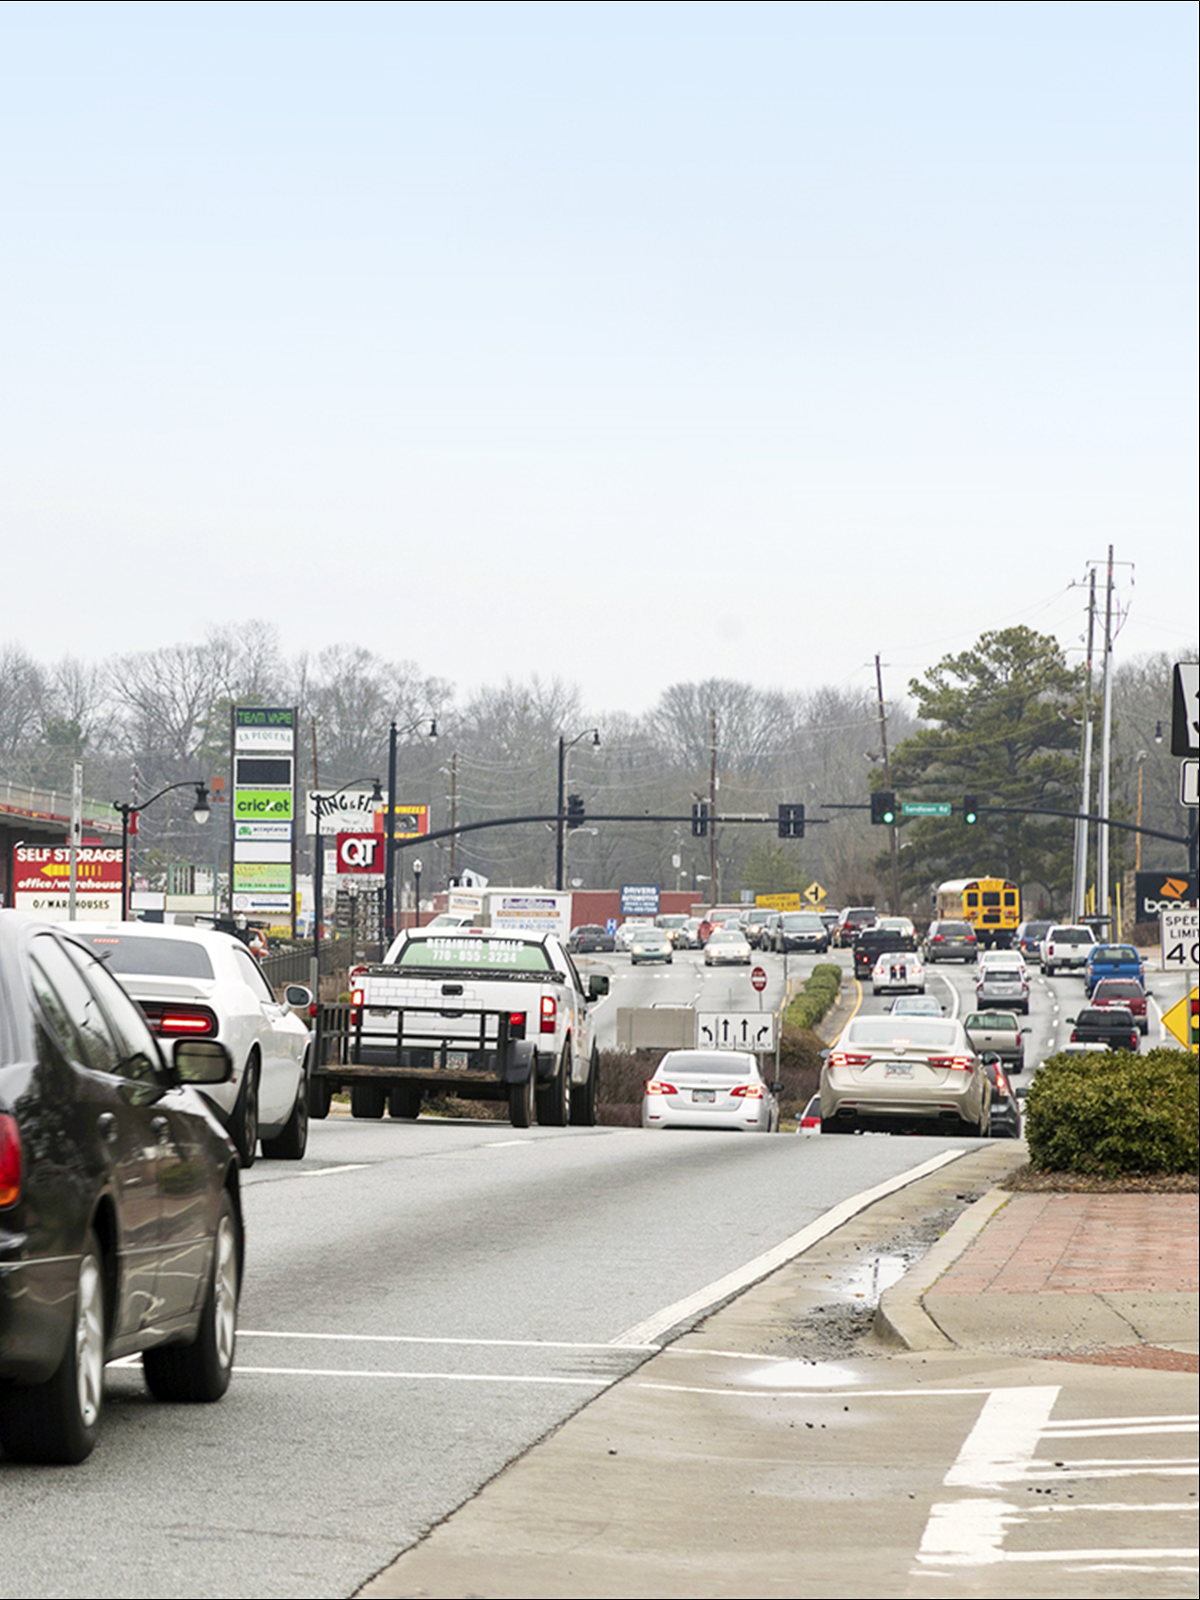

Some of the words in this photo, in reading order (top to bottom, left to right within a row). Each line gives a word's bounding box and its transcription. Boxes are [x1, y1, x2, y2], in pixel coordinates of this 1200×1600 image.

[238, 711, 266, 724] TEAM
[267, 711, 292, 724] VAPE
[237, 798, 290, 812] cricket
[939, 805, 948, 813] Rd
[17, 848, 52, 862] SELF
[54, 849, 123, 863] STORAGE
[341, 838, 378, 867] QT
[1165, 915, 1199, 927] SPEE
[426, 938, 483, 950] RETAINING
[488, 940, 525, 952] WALLS
